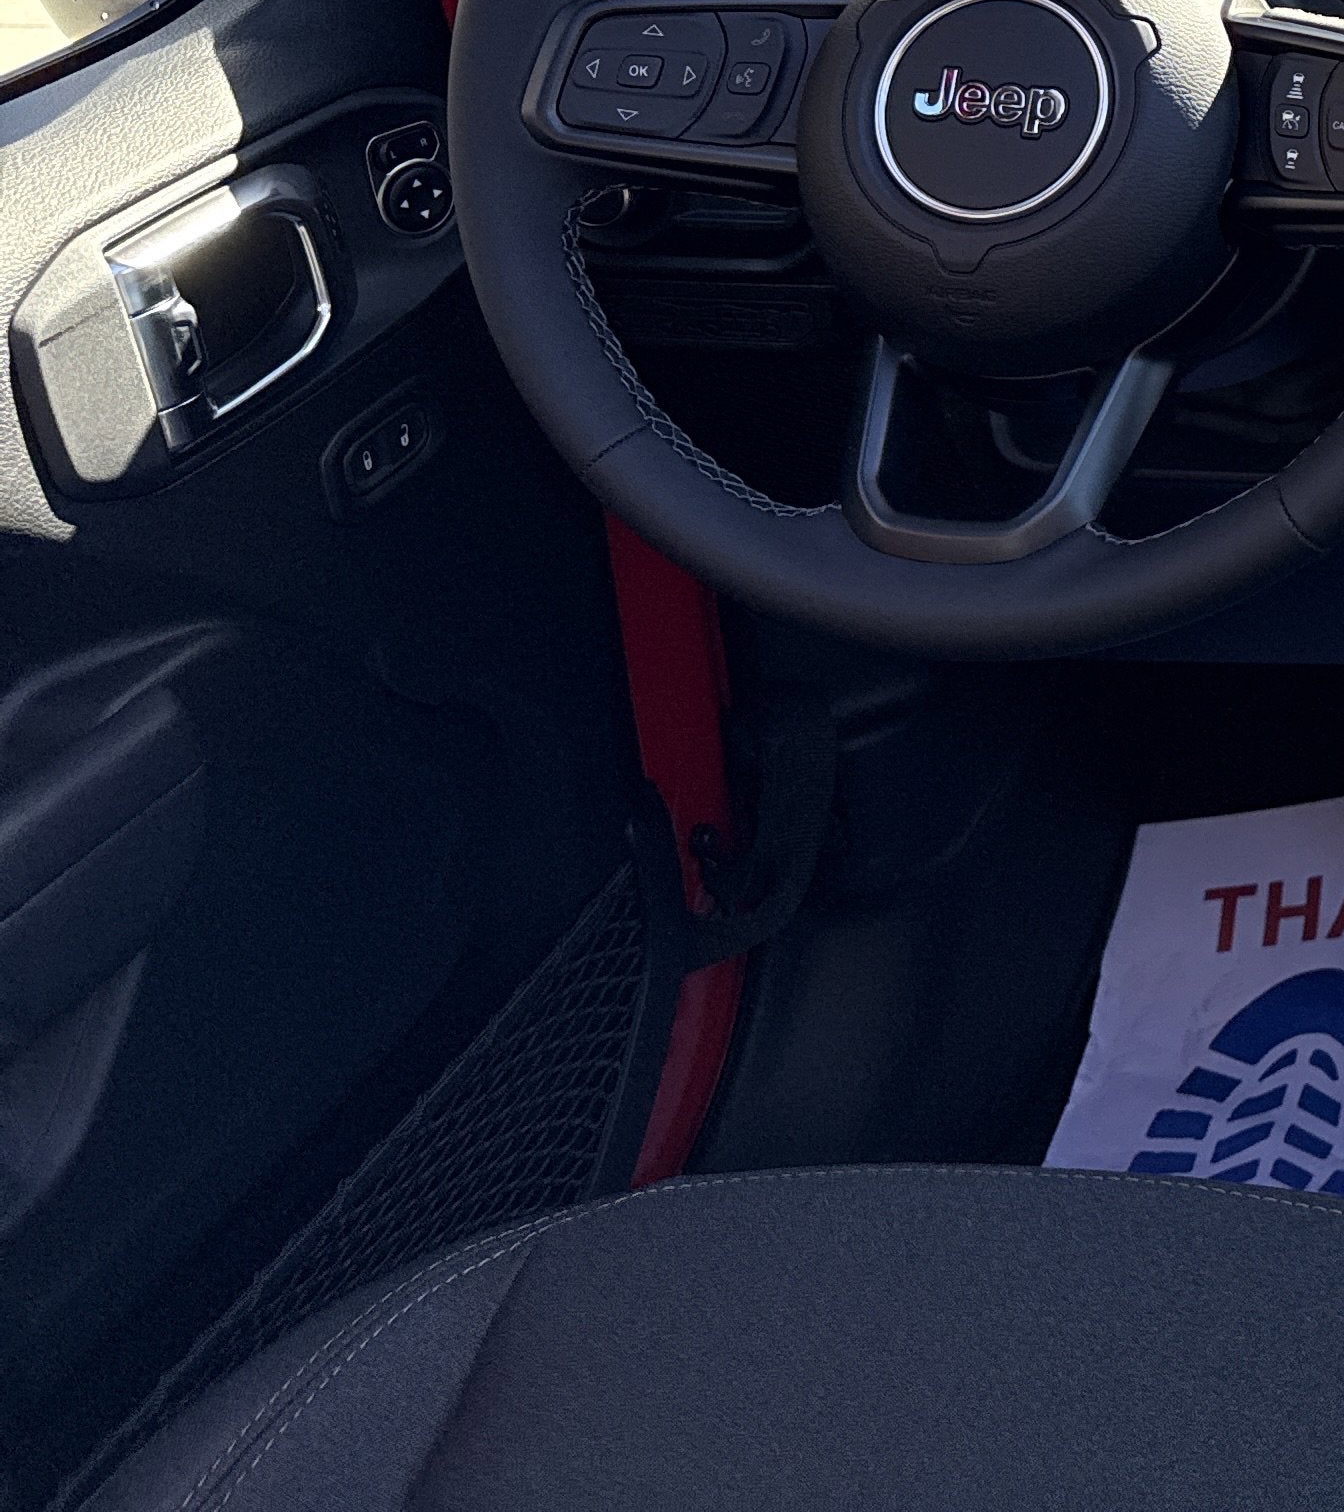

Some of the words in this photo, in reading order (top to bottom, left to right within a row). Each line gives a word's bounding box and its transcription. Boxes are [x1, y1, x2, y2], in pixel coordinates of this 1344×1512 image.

[629, 65, 648, 77] OK
[914, 67, 1067, 135] Jeep
[420, 138, 428, 147] R
